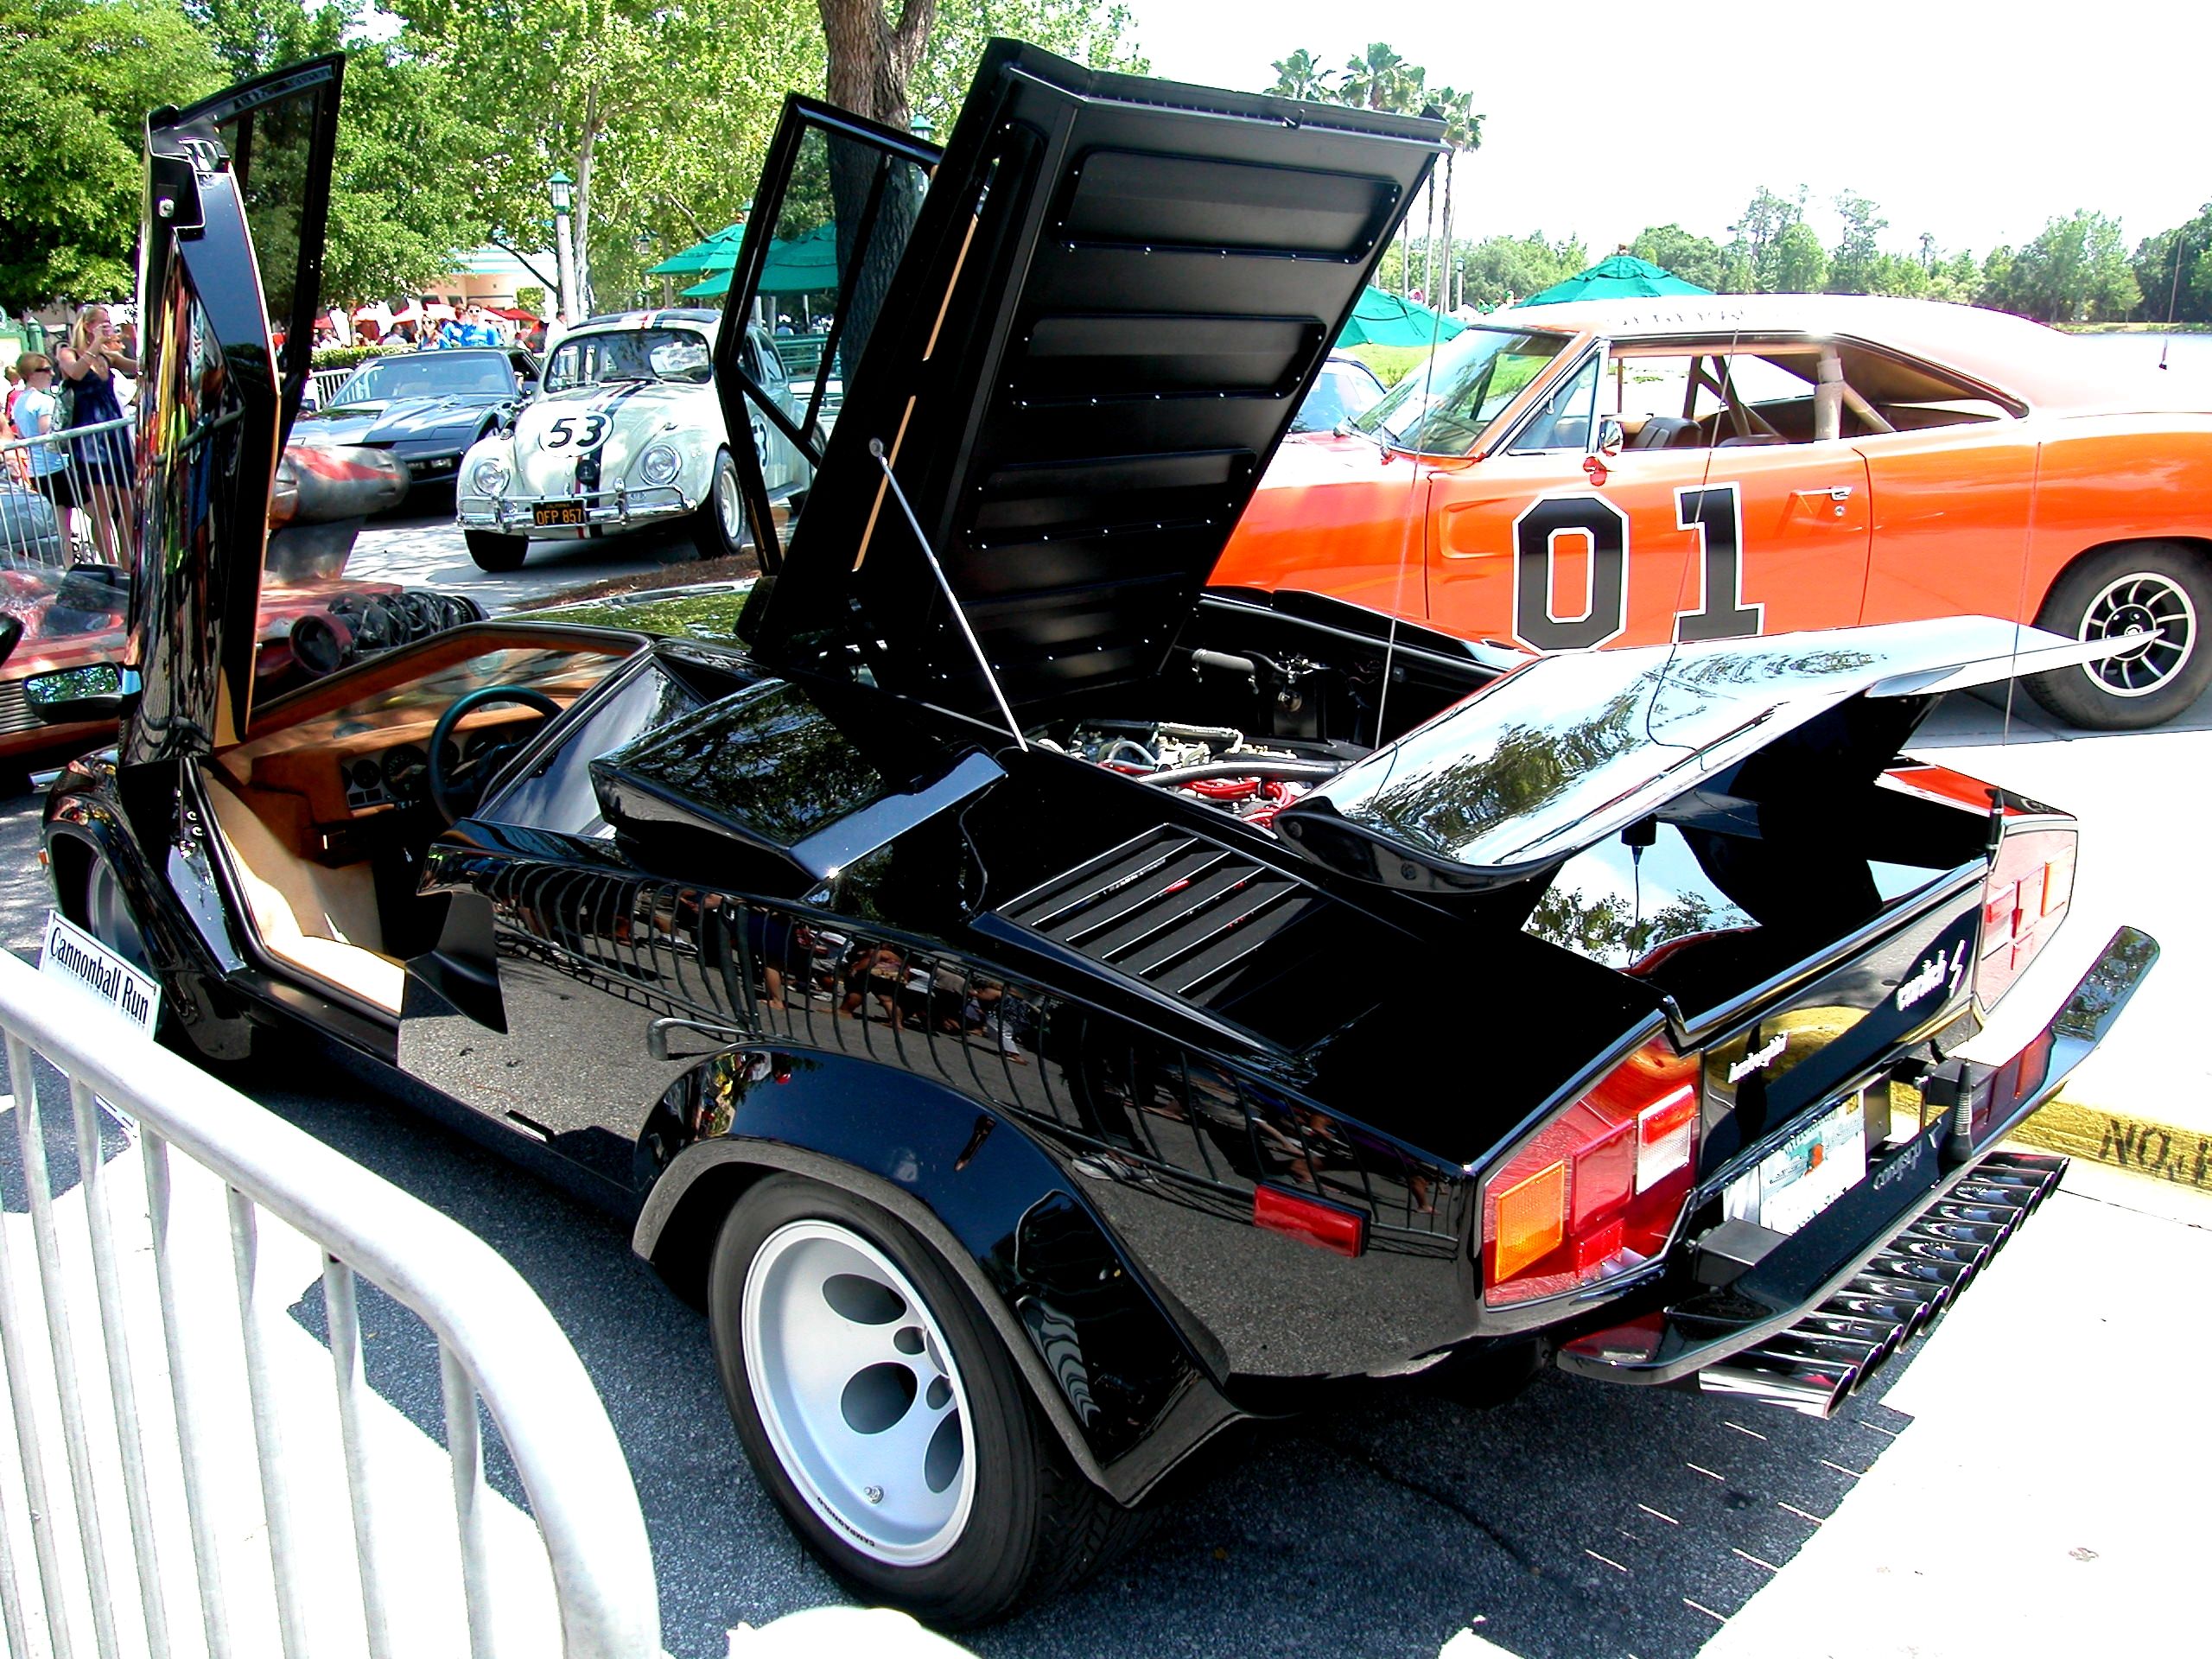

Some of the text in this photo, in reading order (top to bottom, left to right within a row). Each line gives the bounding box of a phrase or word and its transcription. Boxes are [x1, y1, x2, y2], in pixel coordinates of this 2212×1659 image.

[548, 415, 606, 448] 53
[536, 508, 582, 525] OFP 857
[1512, 482, 1765, 657] 01
[50, 926, 149, 1025] Cannonball Run
[2097, 1118, 2171, 1169] NO
